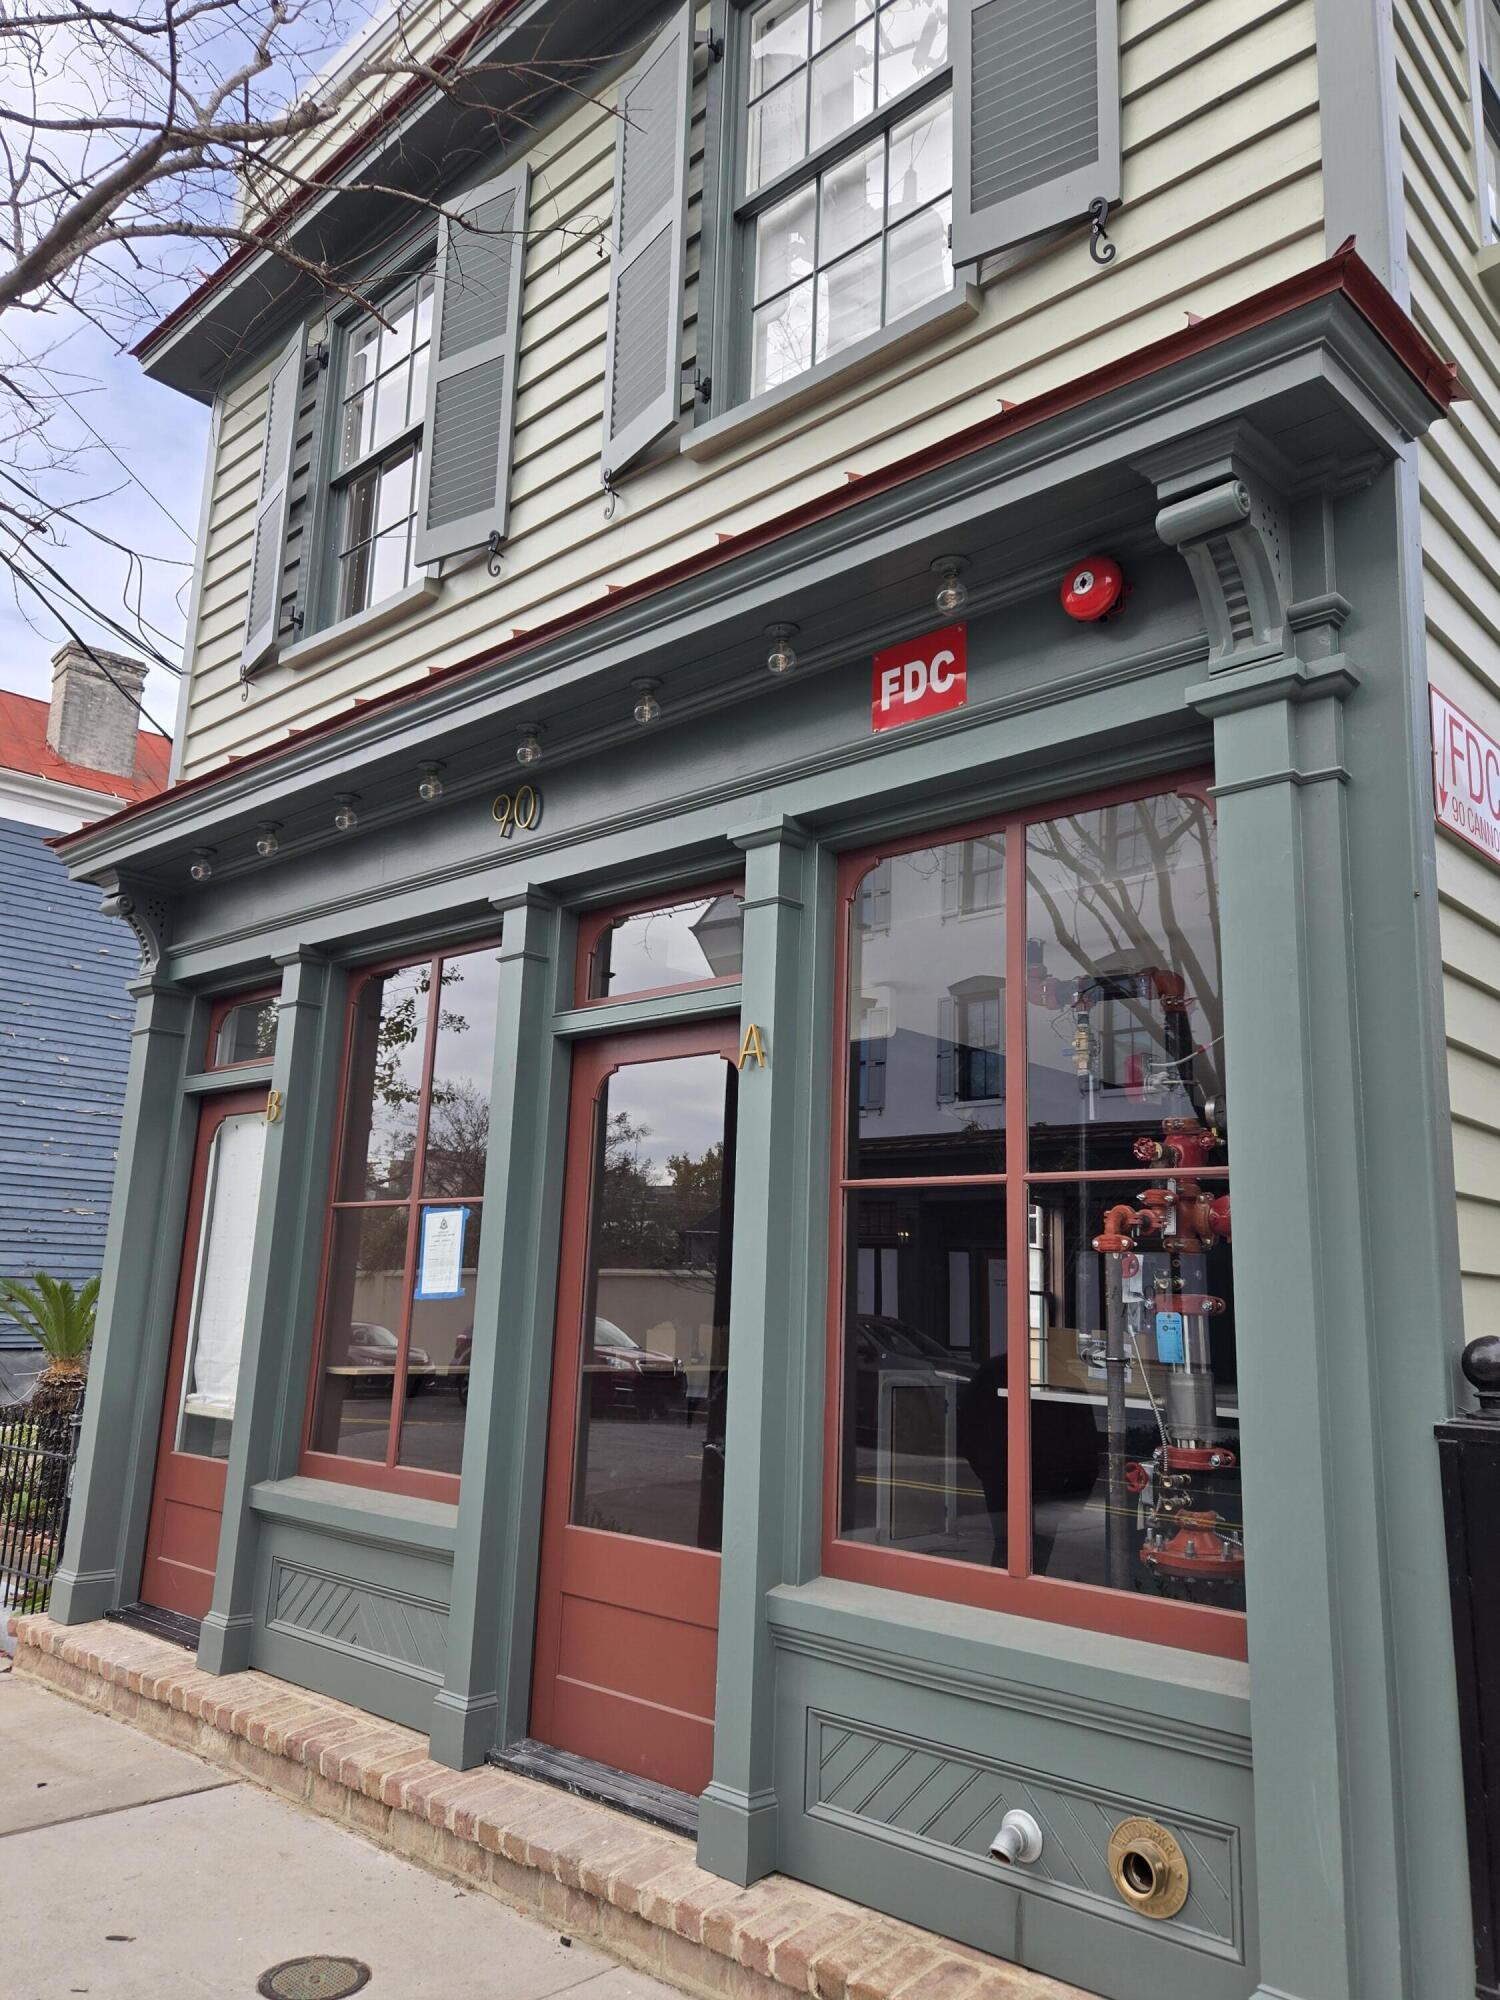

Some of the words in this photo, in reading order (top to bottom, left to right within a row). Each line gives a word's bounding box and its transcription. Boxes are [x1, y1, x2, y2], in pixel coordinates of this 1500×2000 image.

[880, 650, 956, 711] FDC
[1449, 713, 1500, 822] FDC
[492, 785, 536, 838] 90
[1451, 796, 1466, 827] 90
[737, 1023, 766, 1070] A
[266, 1090, 281, 1123] B
